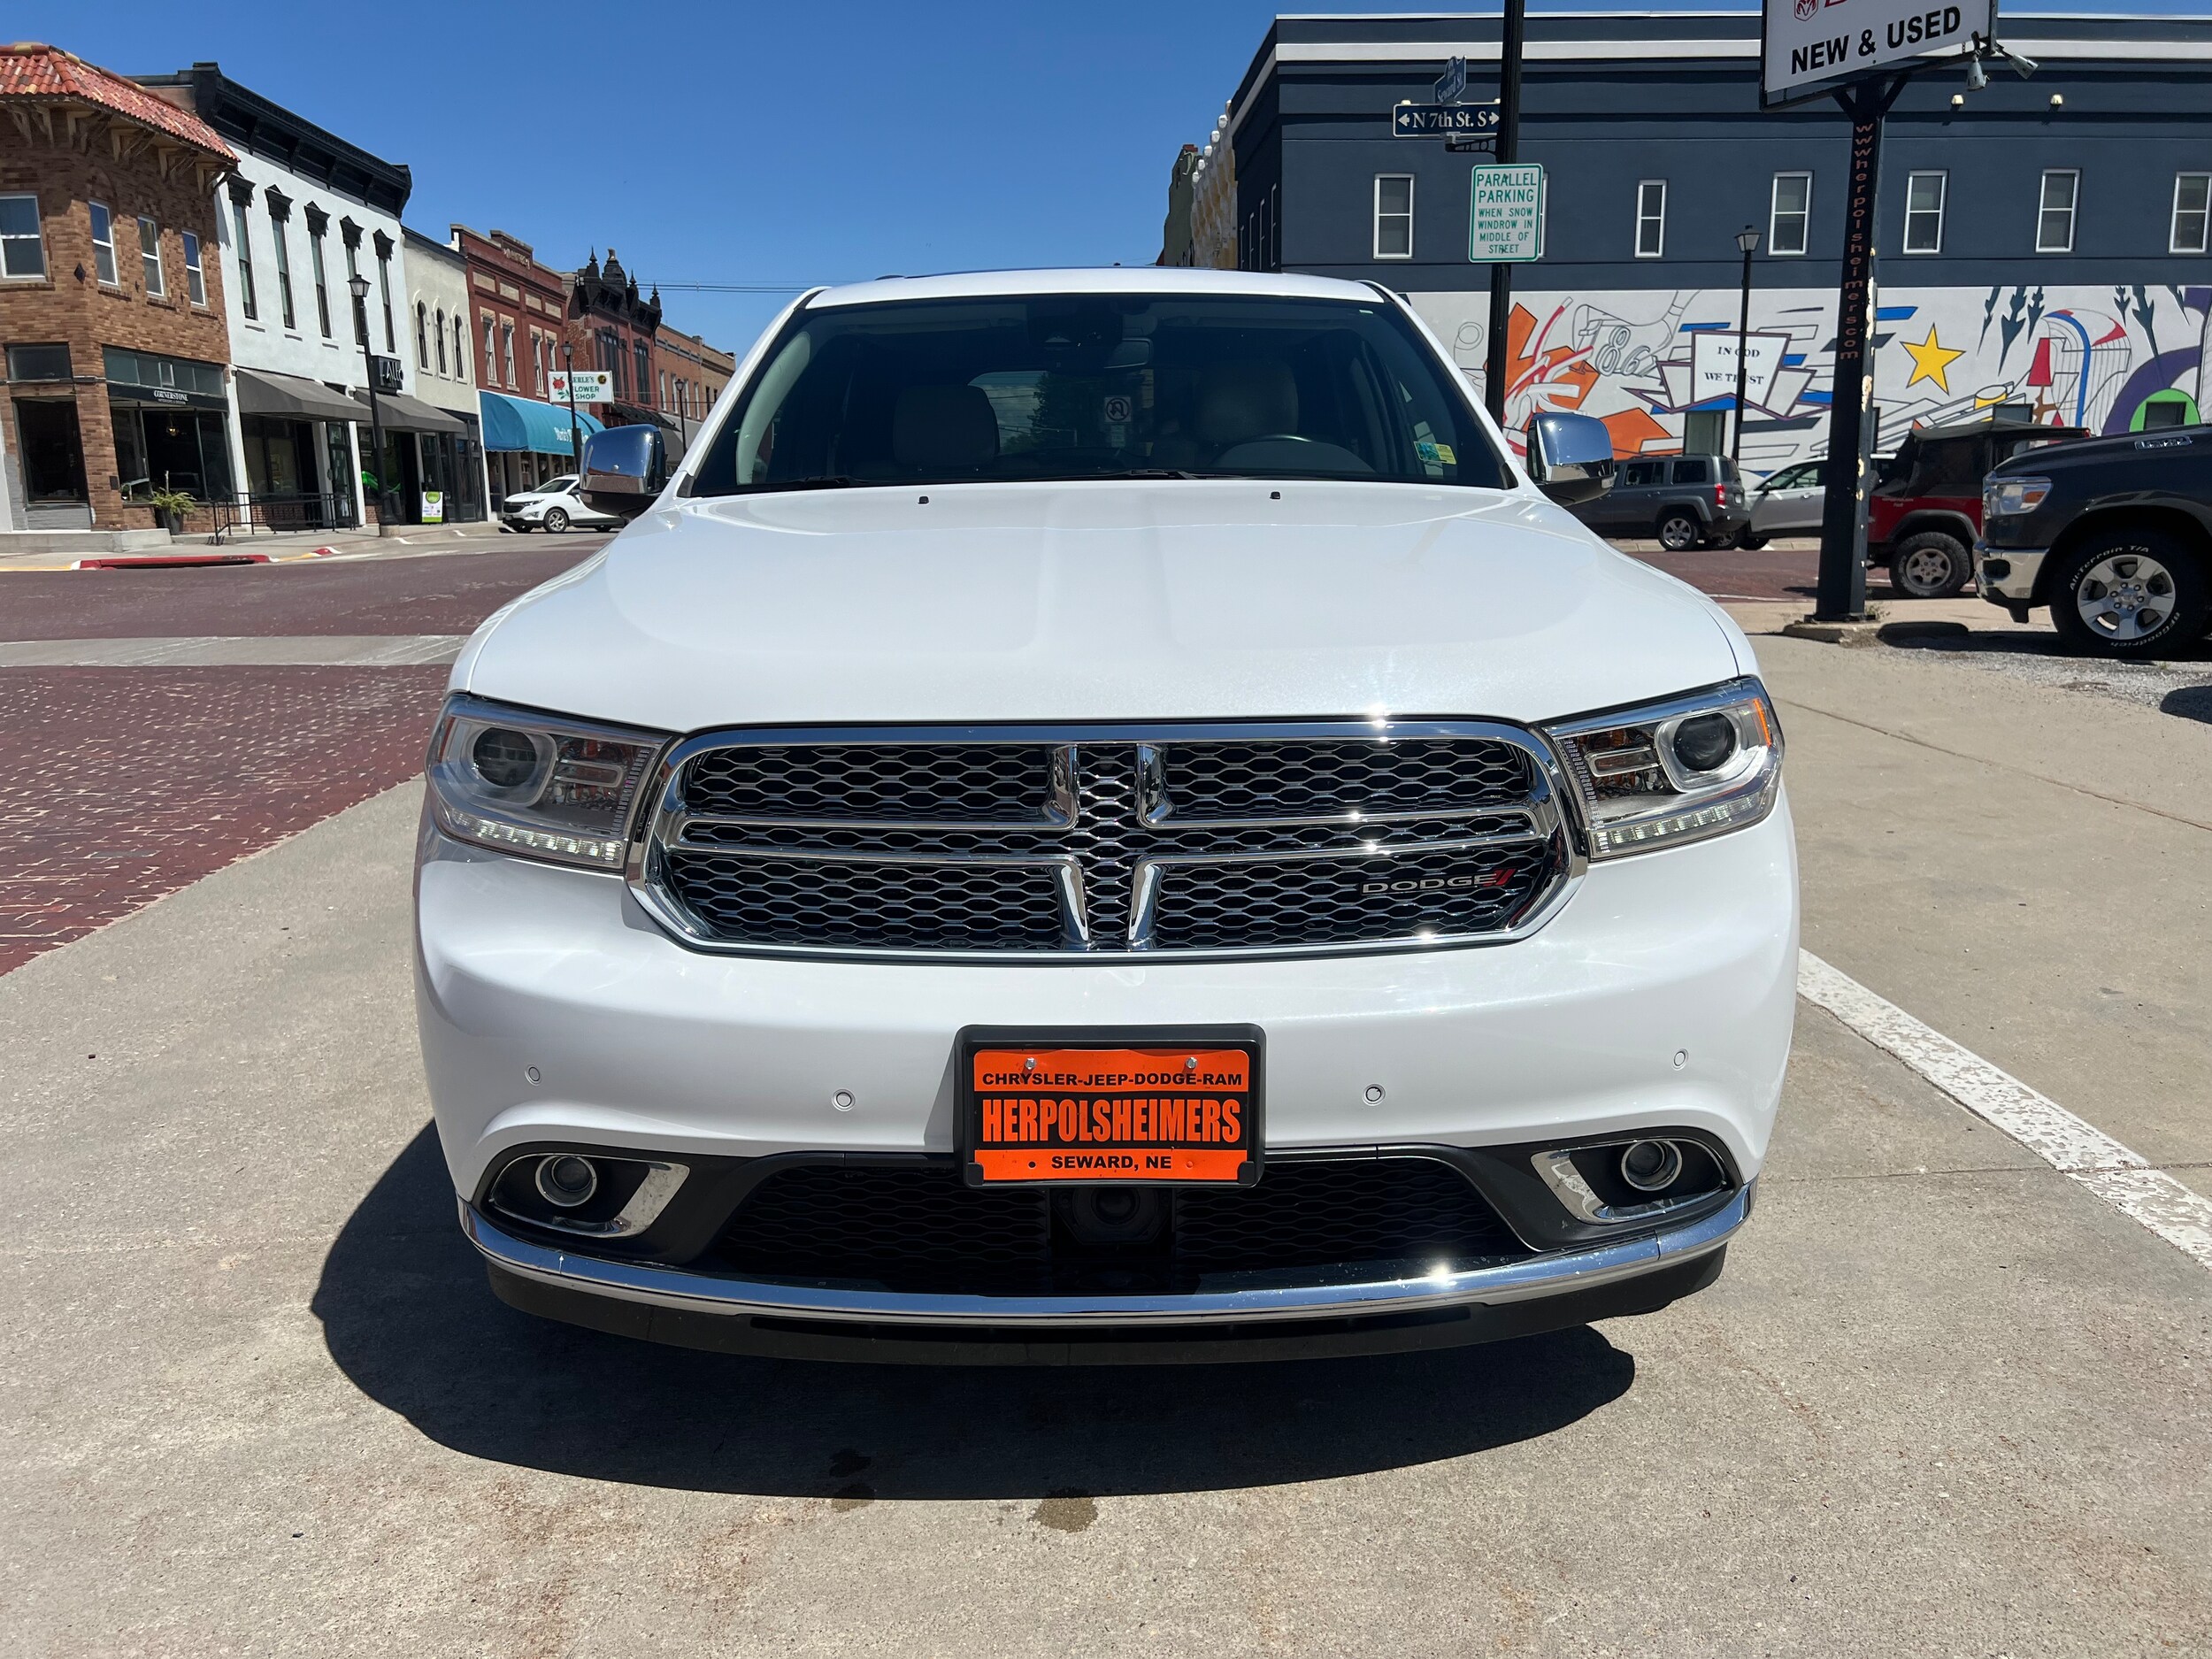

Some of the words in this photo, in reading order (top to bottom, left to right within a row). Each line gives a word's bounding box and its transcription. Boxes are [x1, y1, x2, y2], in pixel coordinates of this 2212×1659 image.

[1791, 35, 1850, 75] NEW
[1858, 28, 1877, 57] &
[1886, 6, 1962, 49] USED
[1412, 112, 1426, 128] N
[1429, 111, 1453, 128] 7th
[1455, 111, 1474, 127] St.
[1478, 111, 1486, 127] S
[1477, 173, 1537, 187] PARALLEL
[1479, 188, 1534, 204] PARKING
[1479, 208, 1502, 218] WHEN
[1509, 207, 1533, 217] SNOW
[1478, 219, 1517, 229] WINDROW
[1524, 219, 1532, 228] IN
[1479, 232, 1511, 242] MIDDLE
[1517, 232, 1529, 241] OF
[1488, 244, 1519, 254] STREET
[1717, 346, 1732, 356] IN
[1704, 372, 1723, 381] WE
[1362, 872, 1497, 894] DODGE
[982, 1072, 1242, 1087] CHRYSLER-JEEP-DODGE-RAM
[982, 1099, 1240, 1143] HERPOLSHEIMERS
[1051, 1156, 1140, 1172] SEWARD,
[1146, 1156, 1172, 1169] NE
